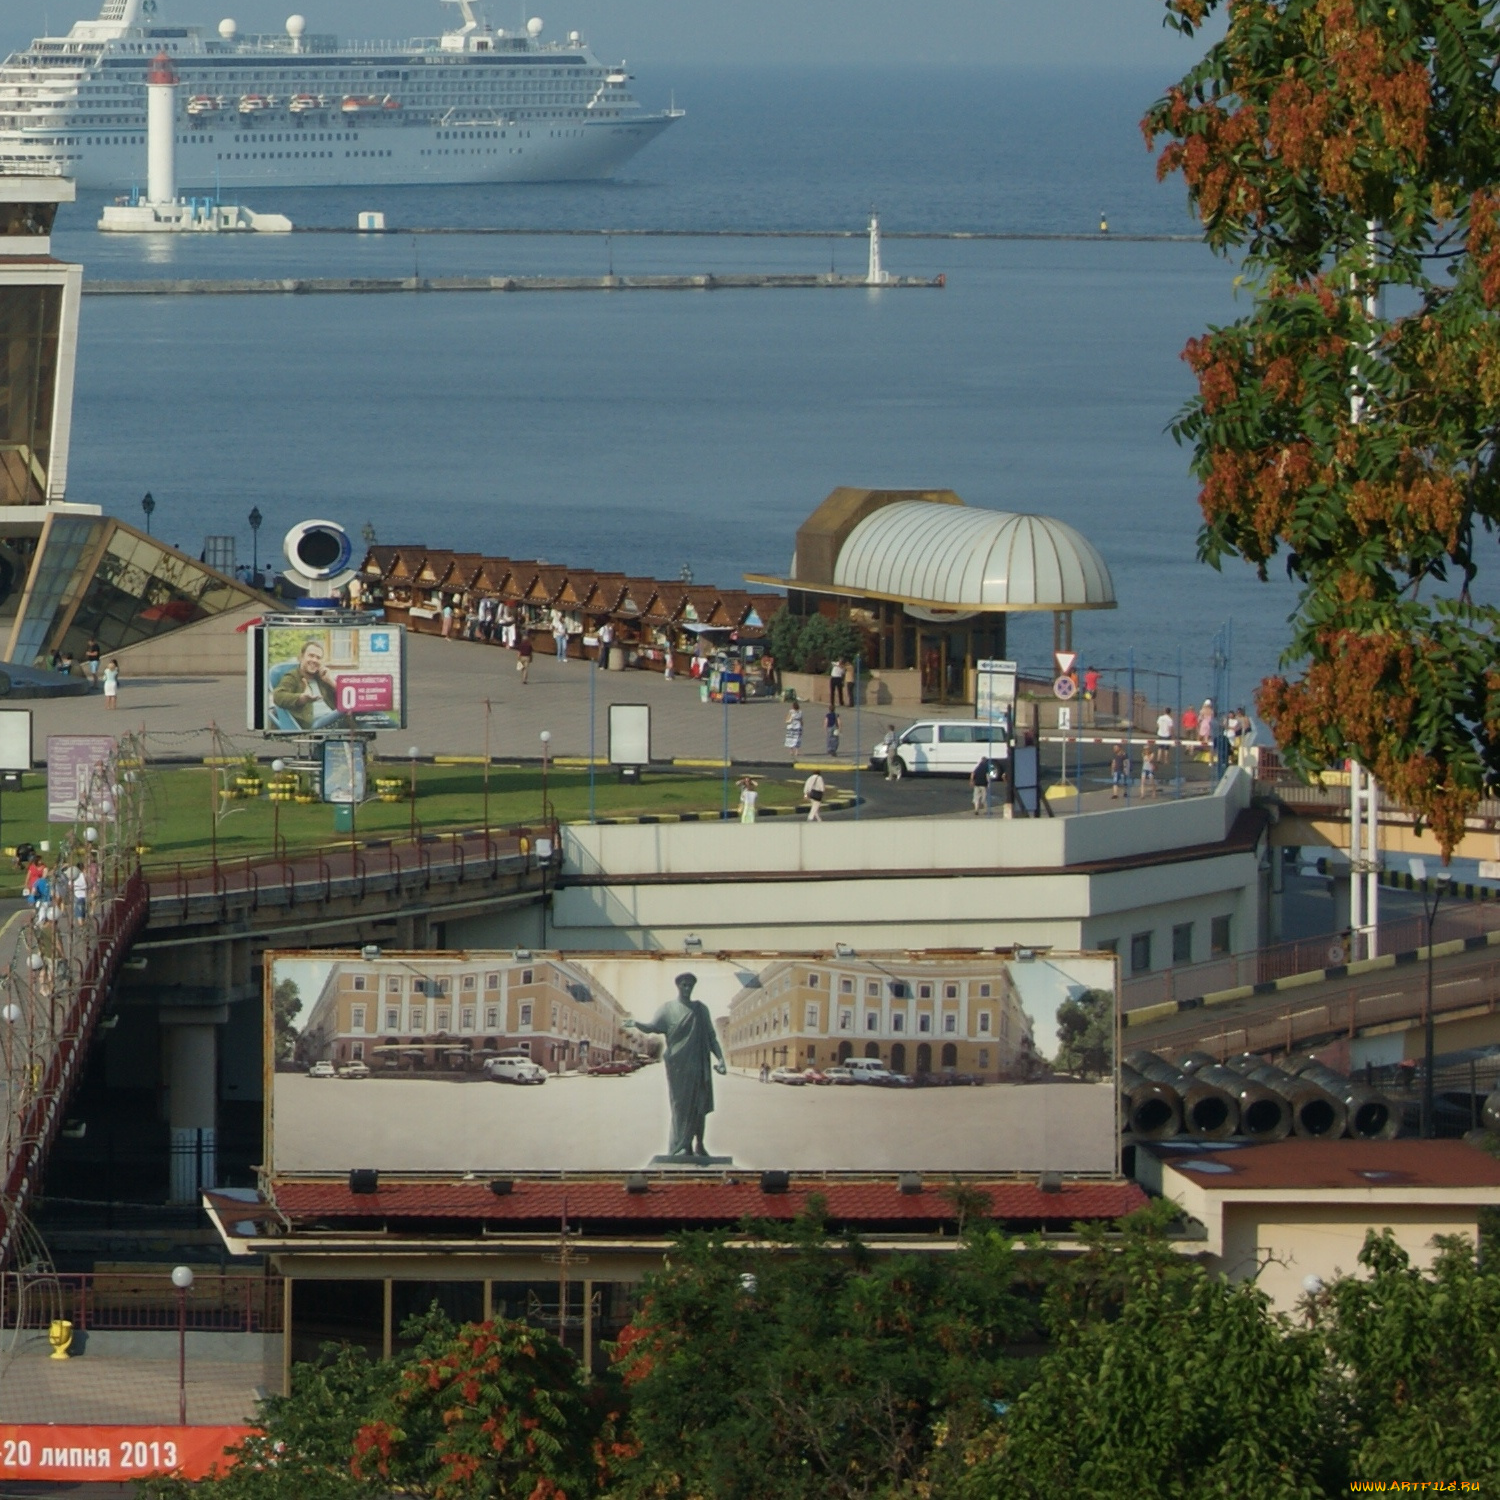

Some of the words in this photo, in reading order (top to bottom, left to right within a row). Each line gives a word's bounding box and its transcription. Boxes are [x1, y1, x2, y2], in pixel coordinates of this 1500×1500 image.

[342, 686, 356, 709] 0
[39, 1442, 112, 1470] липня
[120, 1441, 178, 1468] 2013
